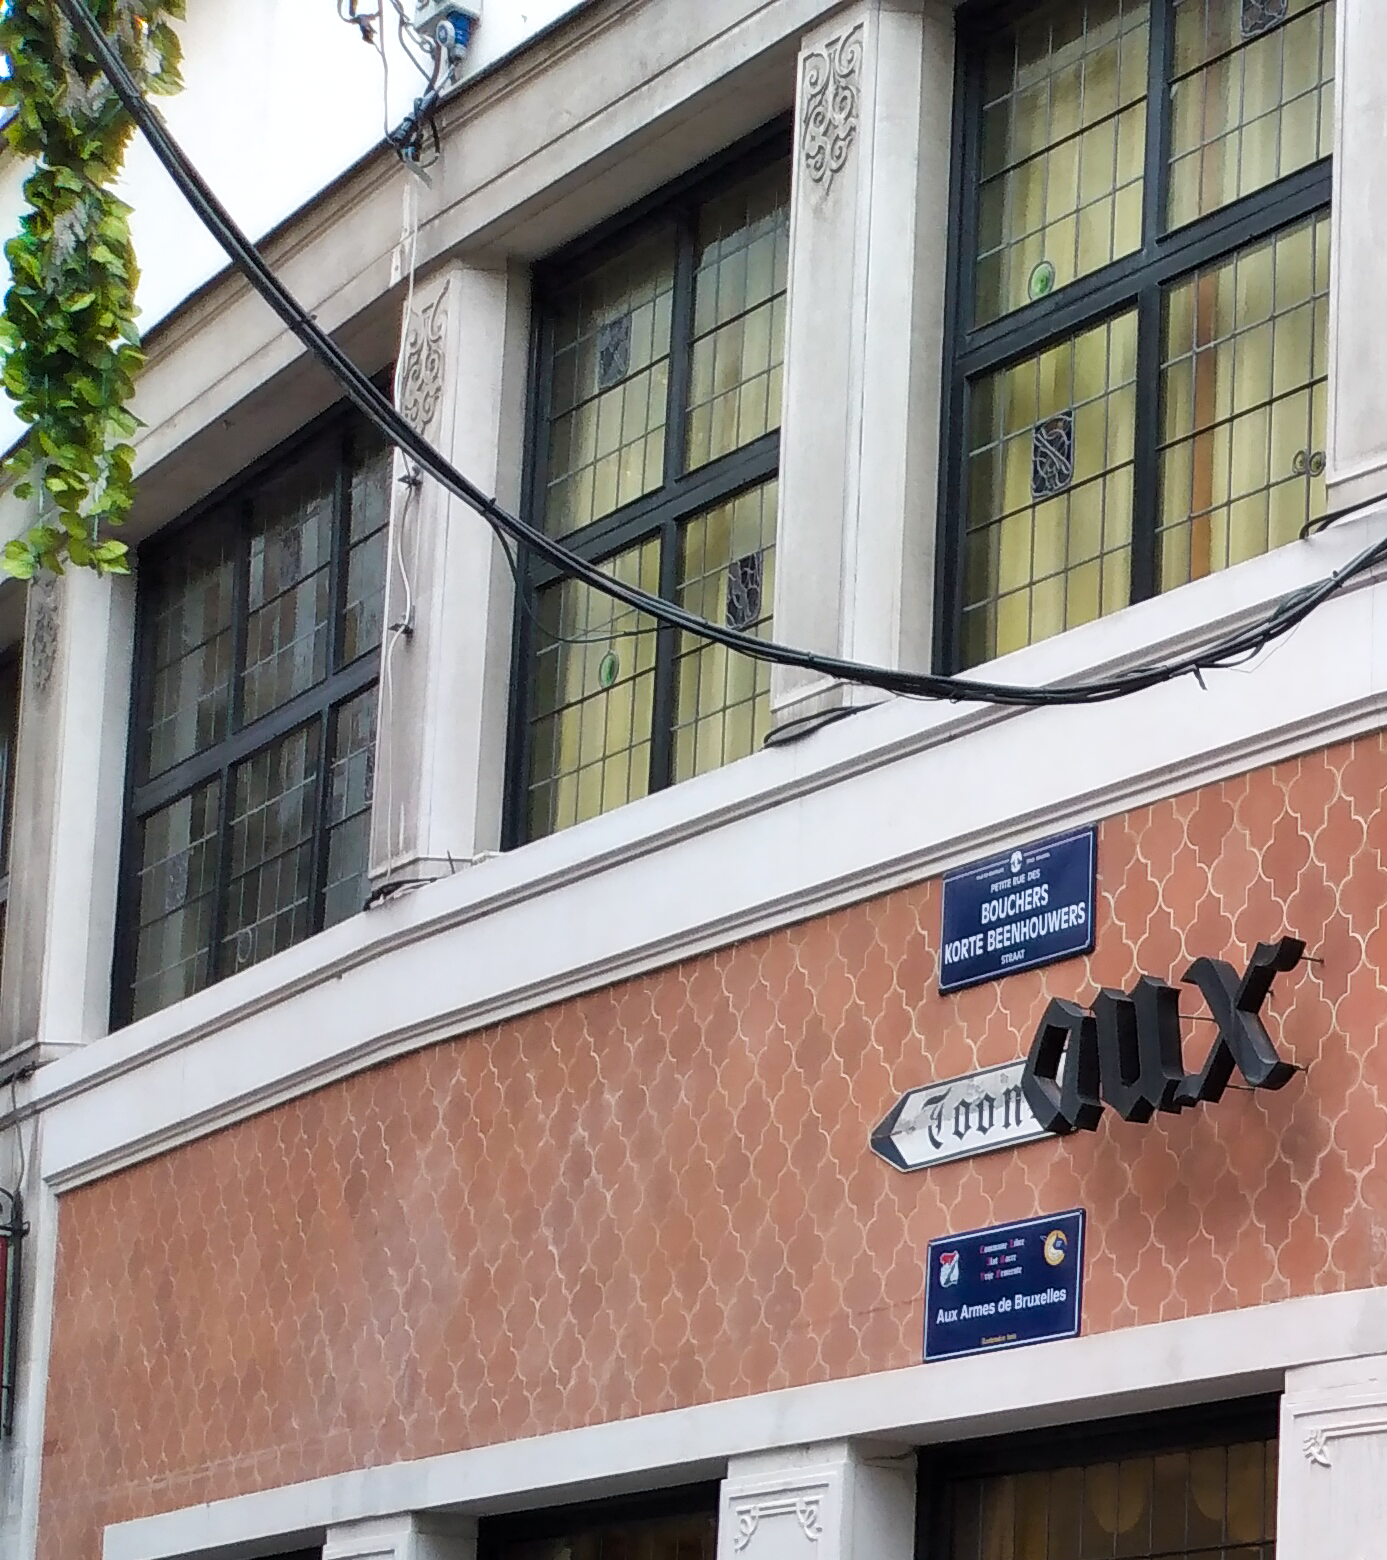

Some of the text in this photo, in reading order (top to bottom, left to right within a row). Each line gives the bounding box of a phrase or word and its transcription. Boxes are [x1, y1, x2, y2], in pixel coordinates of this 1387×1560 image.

[990, 878, 1012, 893] PETITE
[1012, 873, 1026, 887] RUE
[1027, 868, 1041, 882] DES
[981, 883, 1049, 925] BOUCHERS
[944, 902, 1086, 965] KORTE BEENHOUWERS
[1000, 949, 1026, 965] STRAAT
[921, 1085, 1030, 1150] Toon
[936, 1288, 1067, 1324] Aux Armes de Bruxelles
